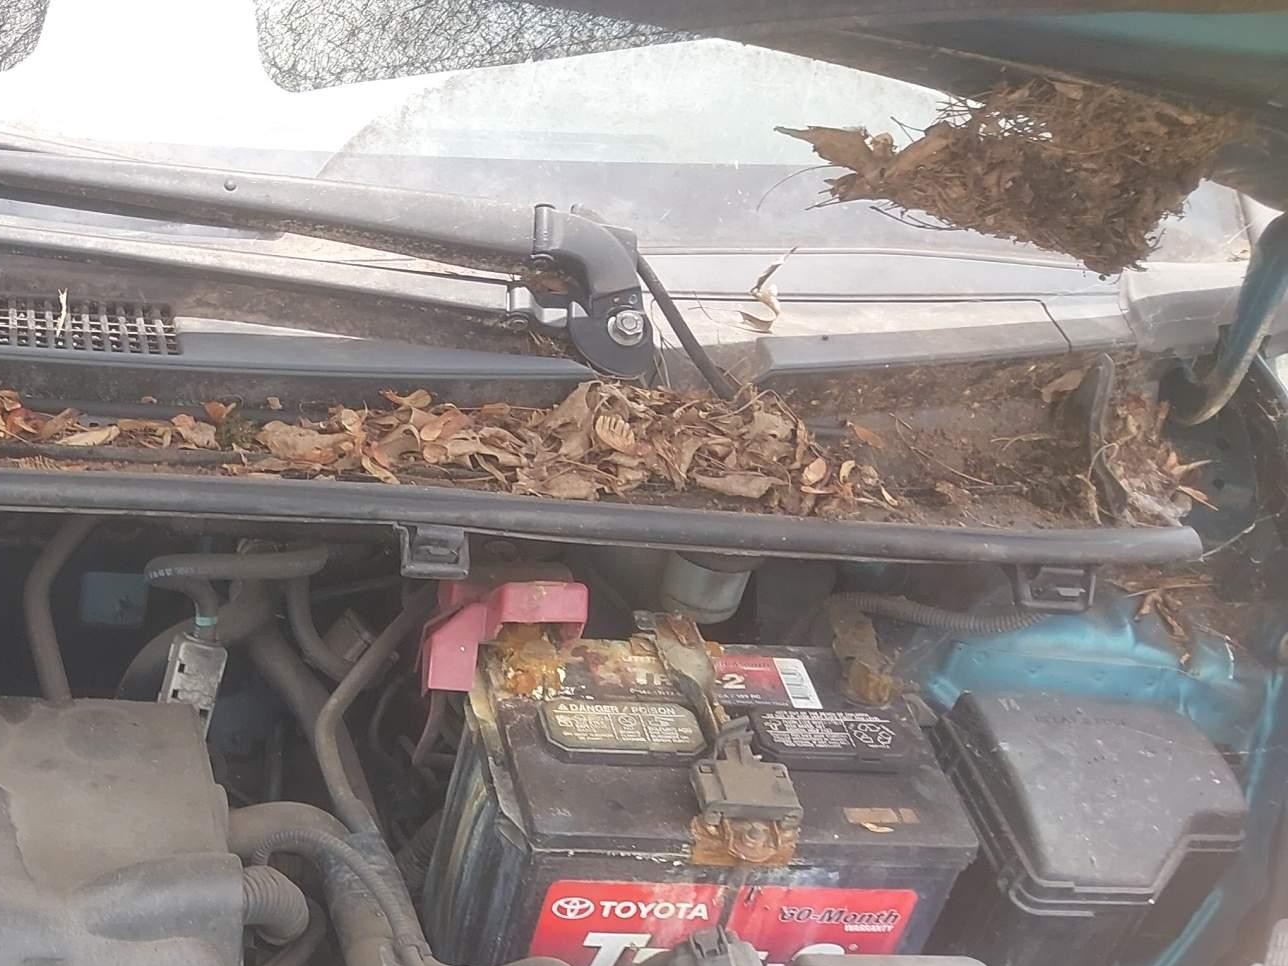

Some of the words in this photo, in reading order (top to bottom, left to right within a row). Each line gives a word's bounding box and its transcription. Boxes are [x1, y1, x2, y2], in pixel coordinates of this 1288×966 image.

[569, 703, 619, 713] DANGER
[631, 706, 676, 715] POISON
[599, 901, 709, 920] TOYOTA
